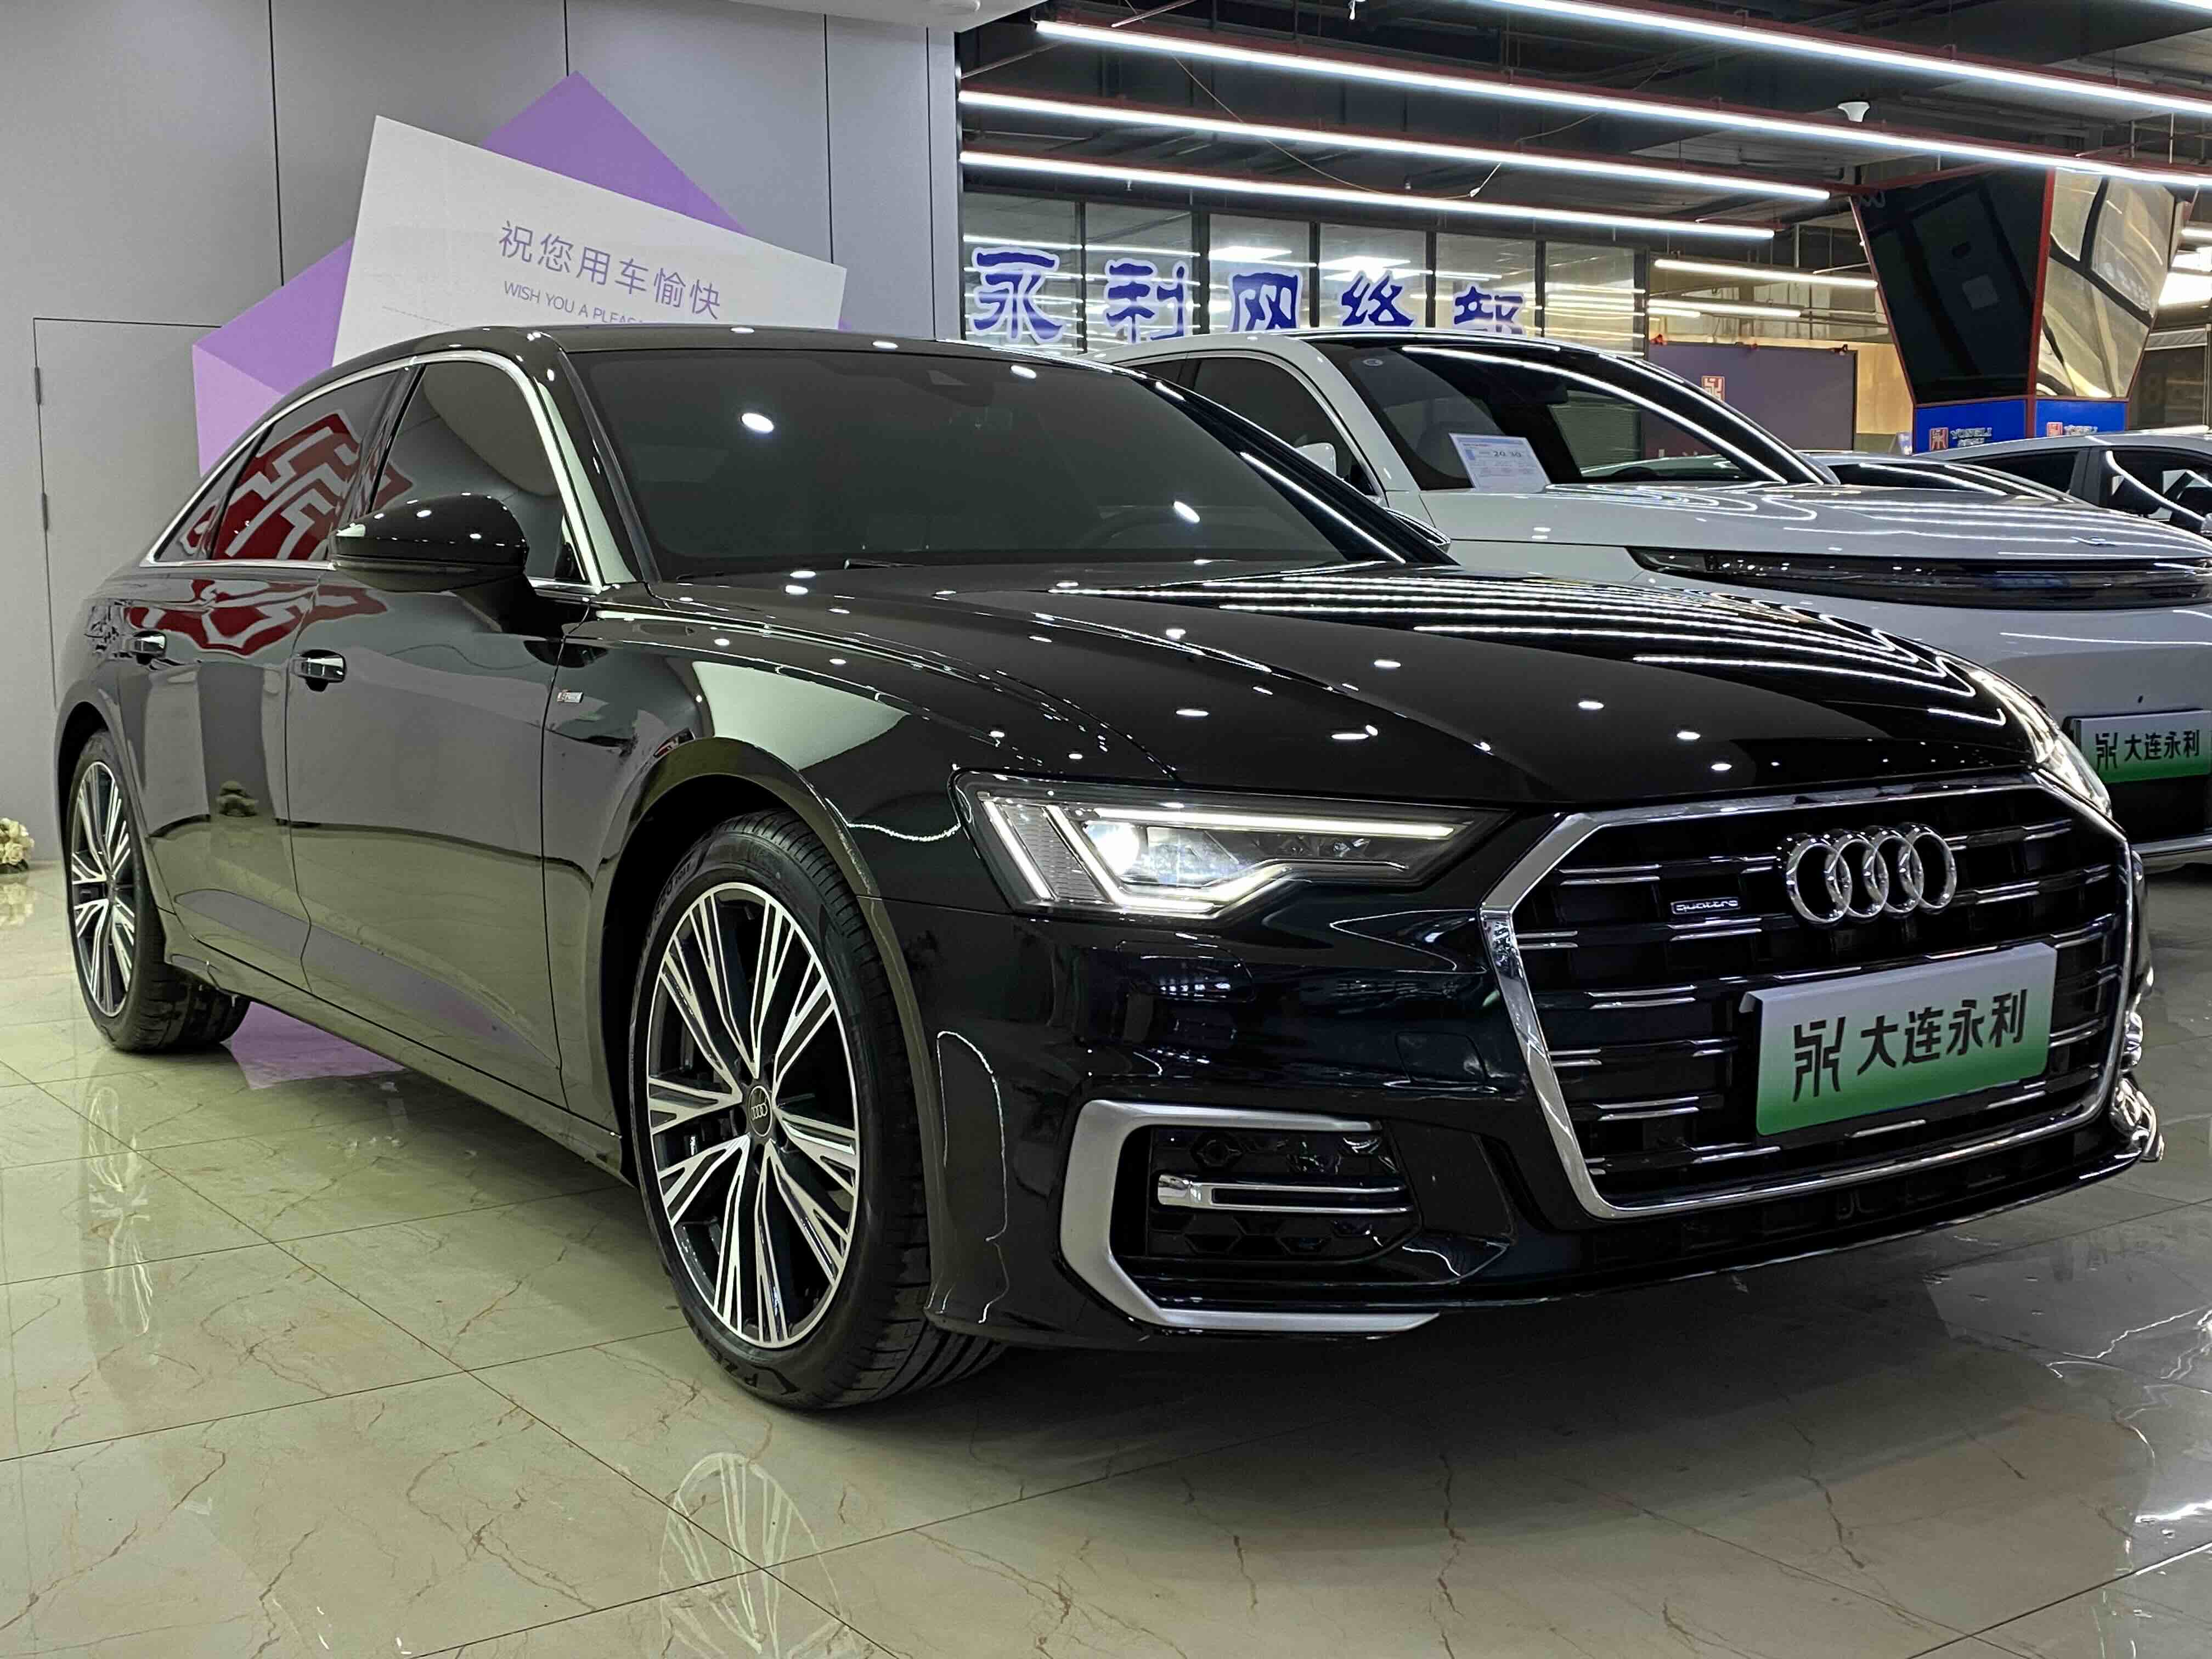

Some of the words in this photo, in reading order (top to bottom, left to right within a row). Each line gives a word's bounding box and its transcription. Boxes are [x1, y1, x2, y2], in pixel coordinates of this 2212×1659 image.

[499, 221, 720, 320] 祝您用车愉快
[504, 280, 540, 303] WISH
[545, 292, 574, 313] YOU
[578, 304, 588, 318] A
[2124, 729, 2200, 761] 大连永利
[1857, 989, 2028, 1075] 大连永利
